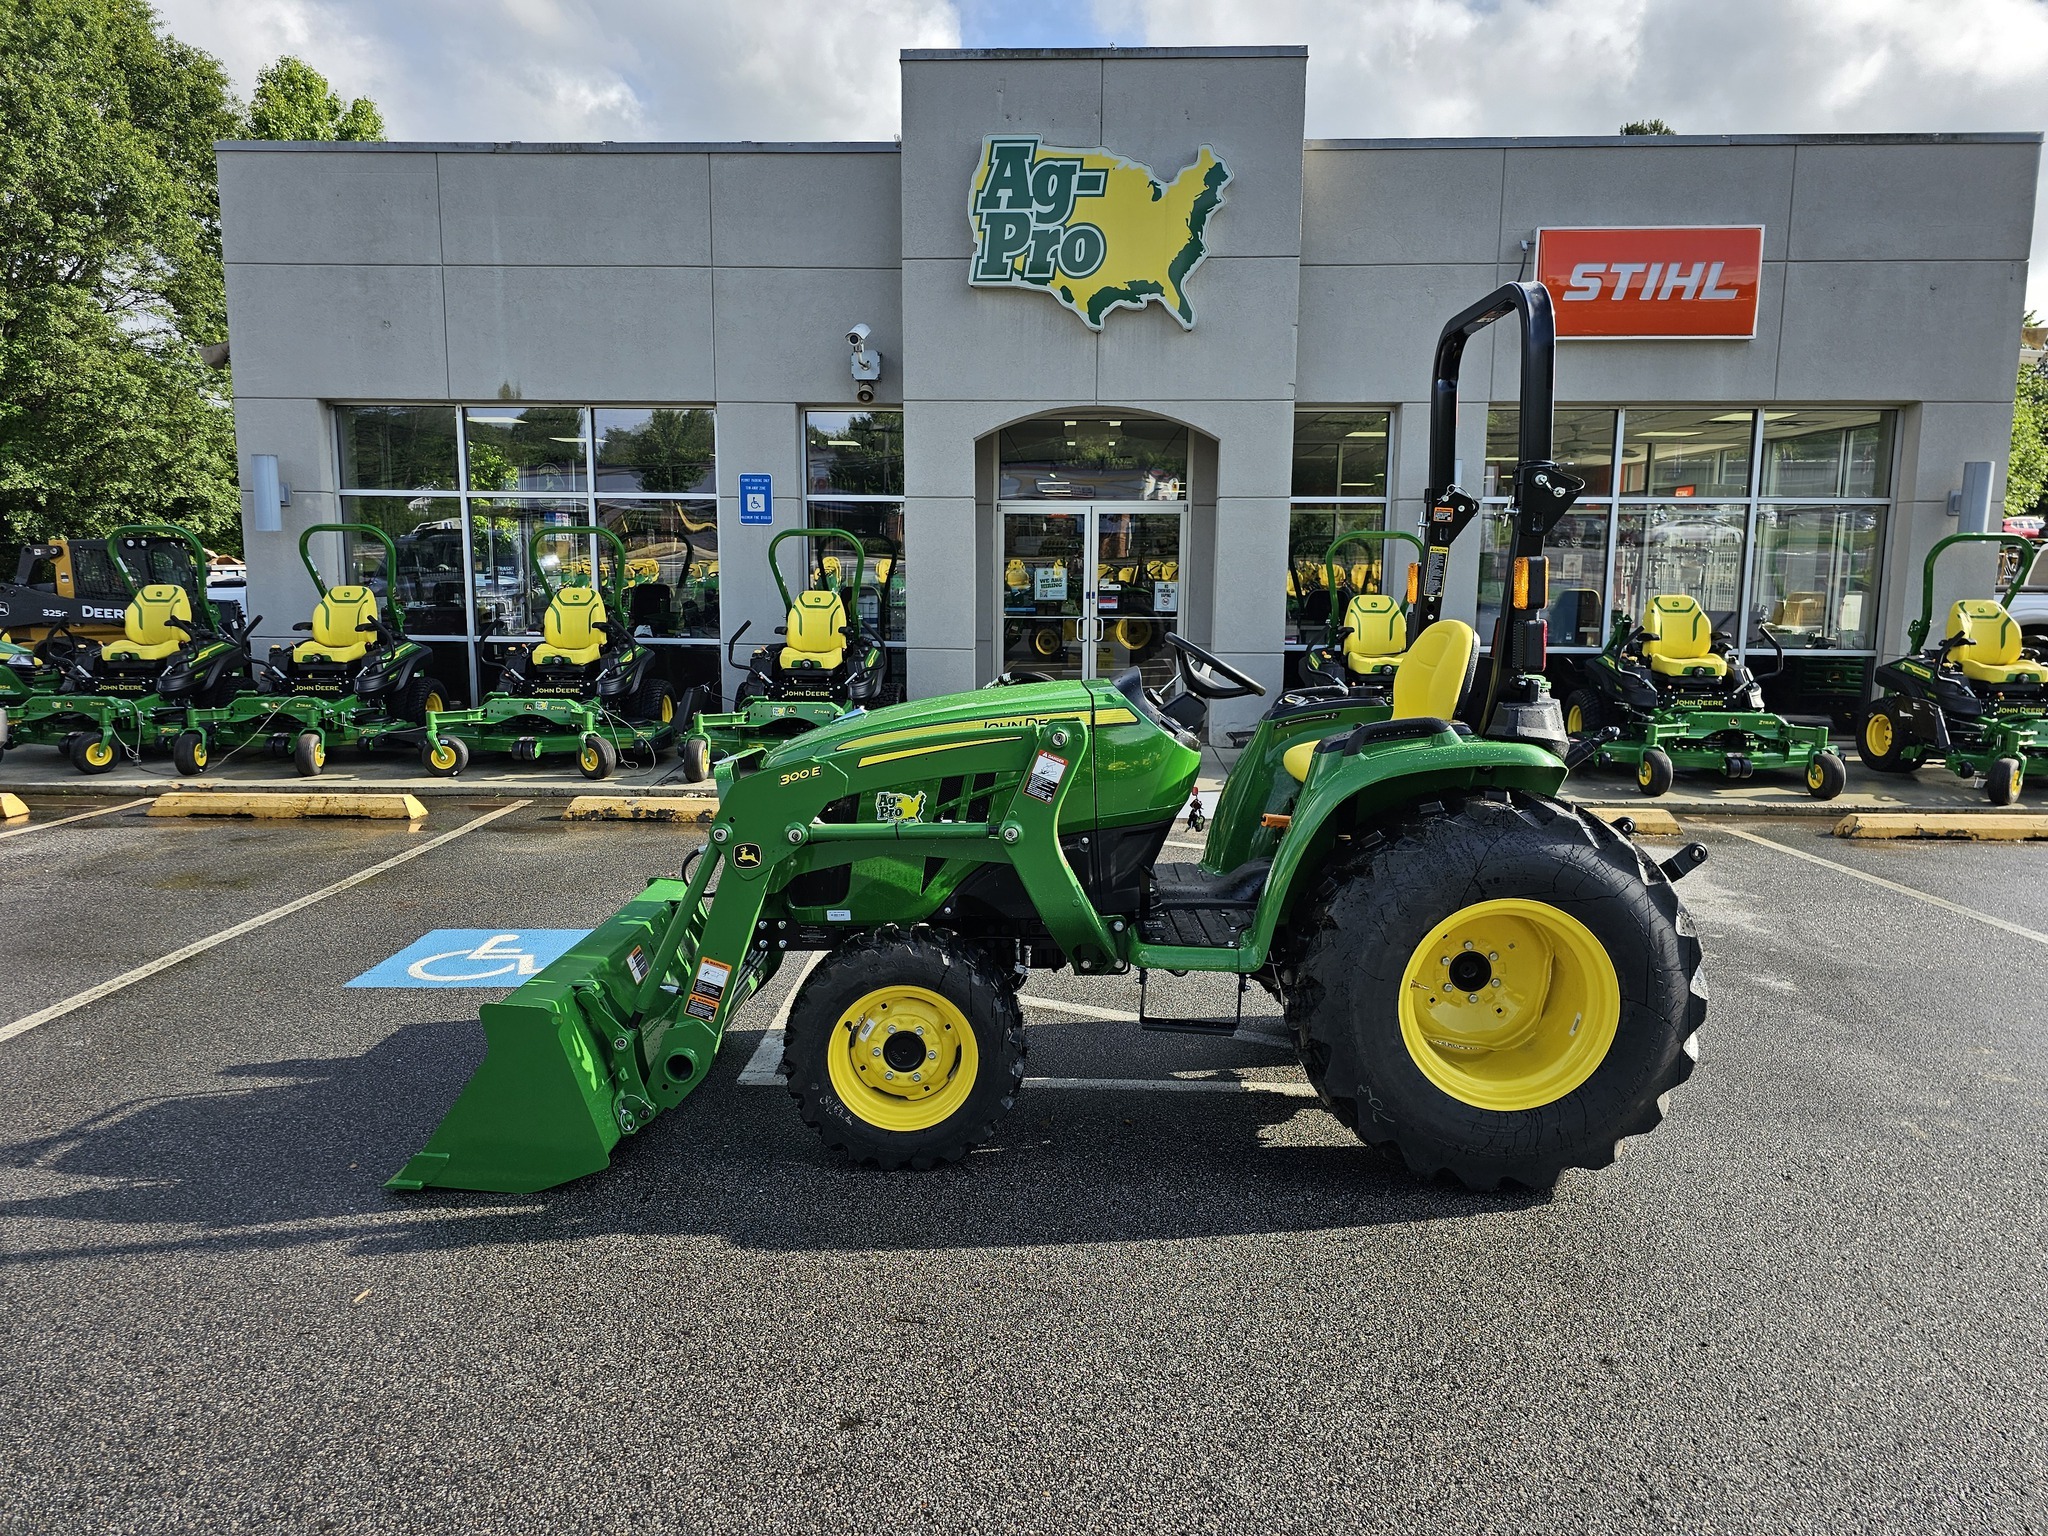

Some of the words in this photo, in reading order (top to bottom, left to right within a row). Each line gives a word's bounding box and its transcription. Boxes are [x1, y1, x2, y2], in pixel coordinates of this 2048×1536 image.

[973, 140, 1109, 226] Ag-
[973, 212, 1107, 281] Pro
[1562, 262, 1739, 301] STIHL
[81, 605, 126, 619] DEER
[780, 770, 810, 786] 300
[811, 766, 822, 777] E
[879, 795, 902, 807] Ag-
[879, 807, 903, 818] Pro
[709, 961, 728, 970] WARNING
[697, 998, 716, 1007] WARNING
